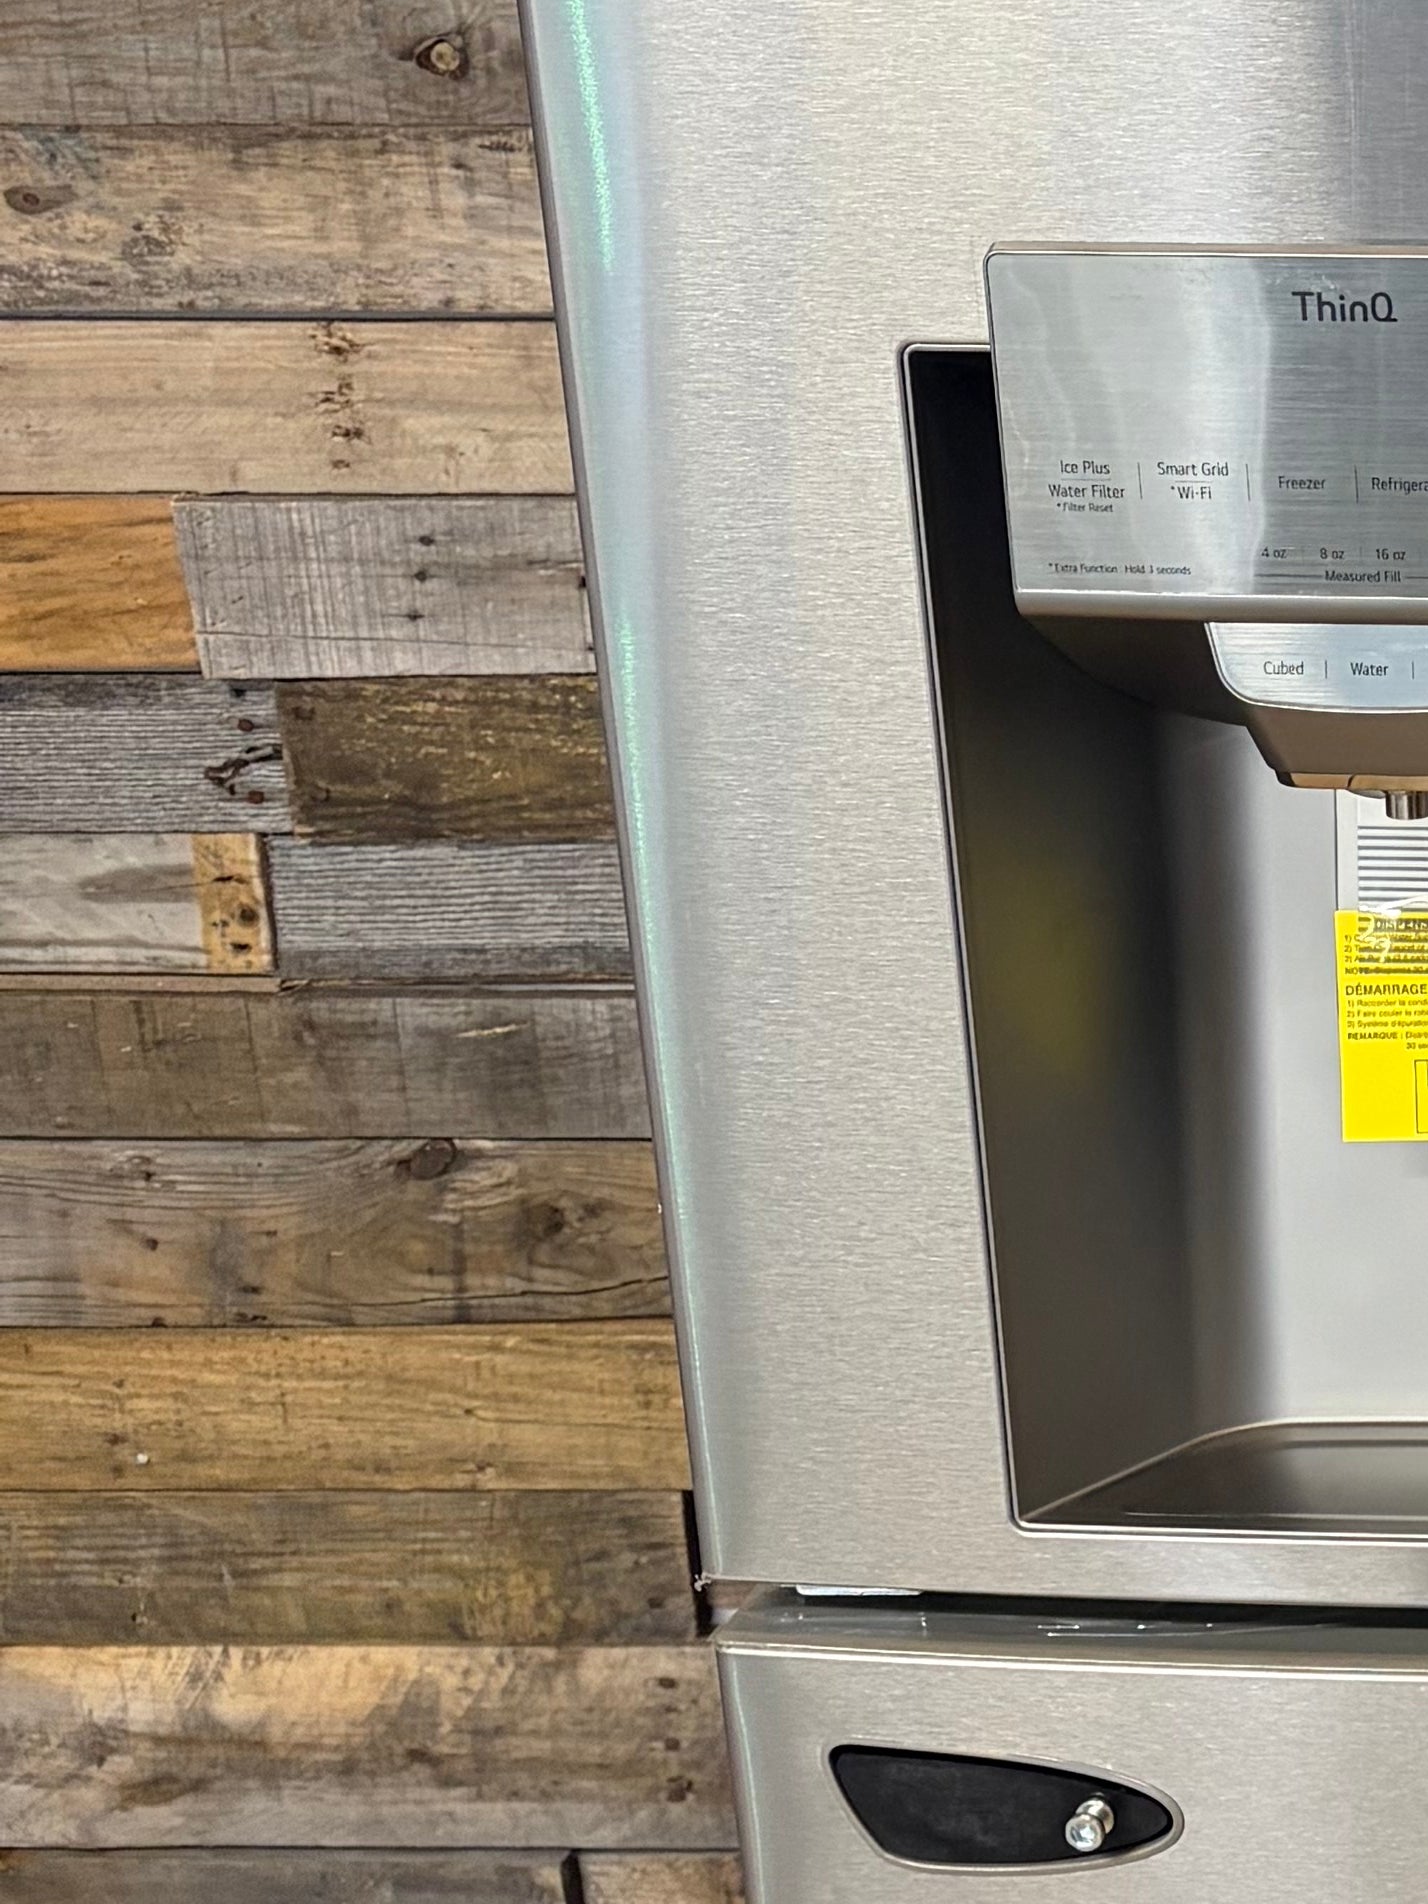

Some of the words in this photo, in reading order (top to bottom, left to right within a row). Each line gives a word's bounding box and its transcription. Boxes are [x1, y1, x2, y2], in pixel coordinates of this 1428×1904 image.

[1291, 290, 1398, 322] ThinQ
[1060, 460, 1078, 474] Ice
[1082, 460, 1110, 475] Plus
[1157, 461, 1197, 476] Smart
[1201, 462, 1229, 476] Grid
[1278, 475, 1326, 489] Freezer
[1048, 484, 1087, 498] Water
[1091, 484, 1125, 499] Filter
[1261, 547, 1270, 559] 4
[1273, 549, 1287, 559] oz
[1319, 547, 1328, 559] 8
[1332, 550, 1345, 560] oz
[1375, 548, 1389, 560] 16
[1393, 550, 1406, 561] oz
[1324, 570, 1381, 583] Measured
[1384, 570, 1401, 583] Fill
[1263, 660, 1304, 675] Cubed
[1350, 662, 1389, 677] Water
[1345, 981, 1428, 996] DÉMARRAGE
